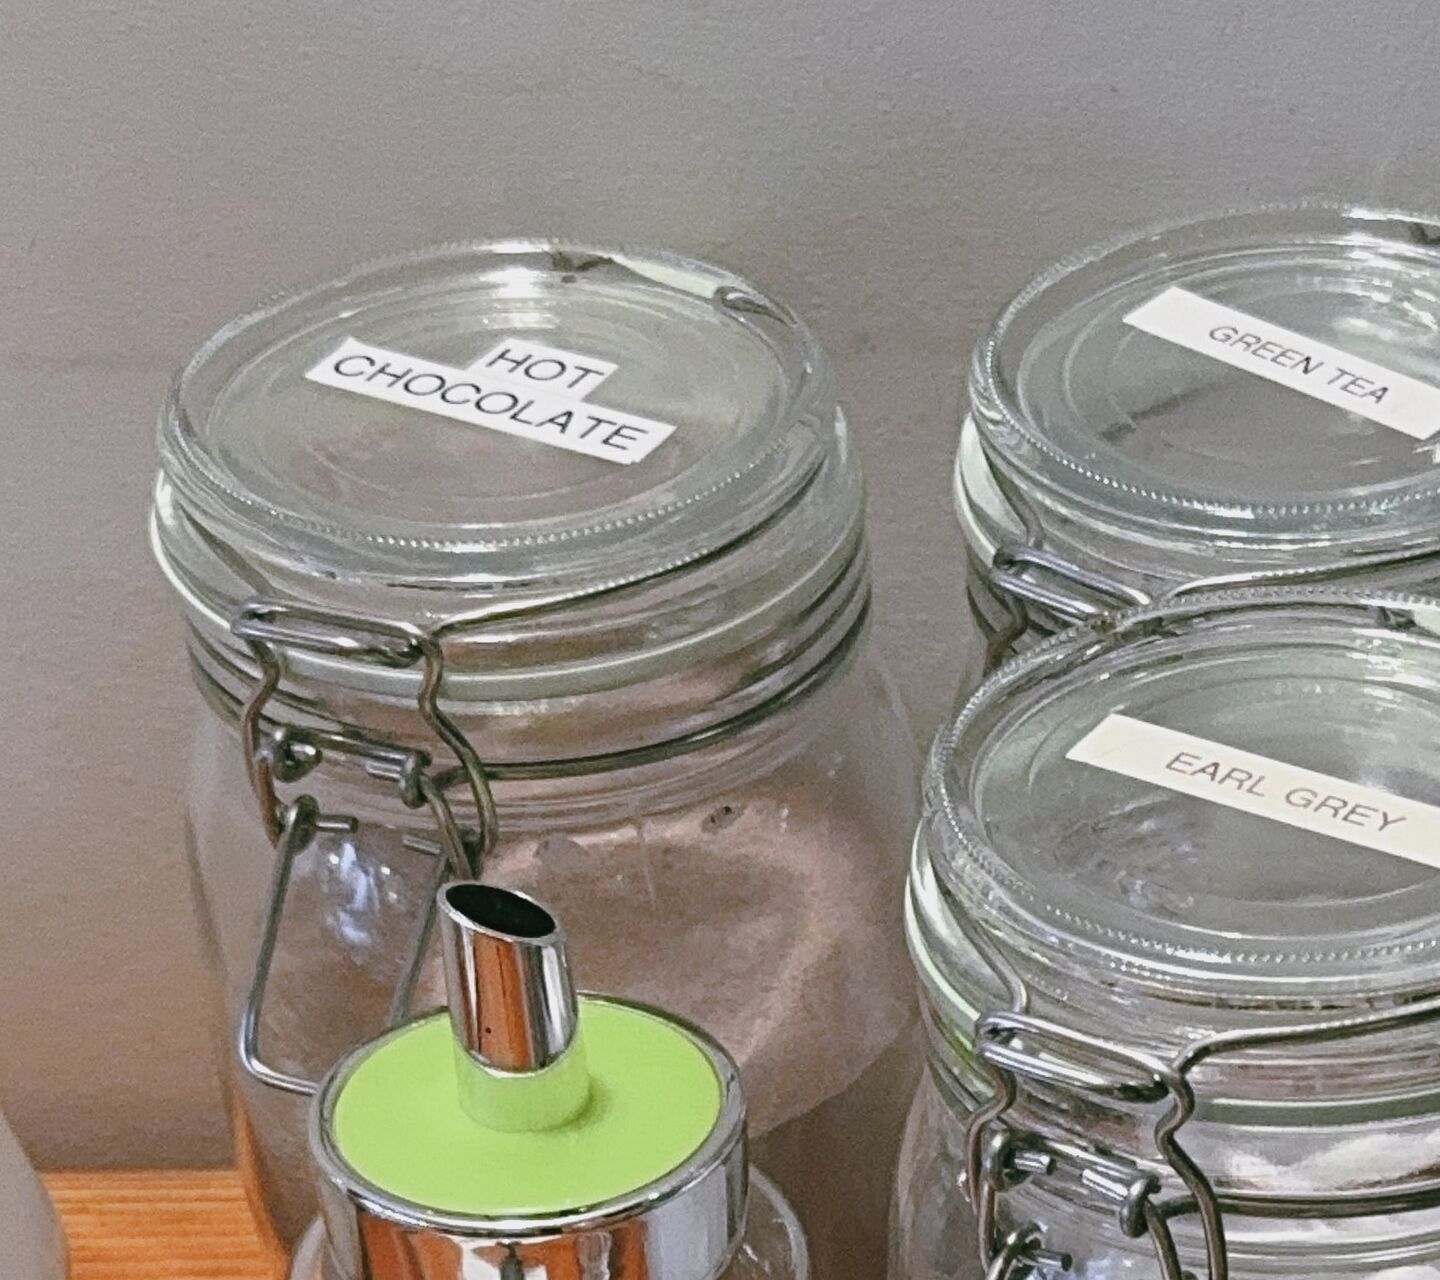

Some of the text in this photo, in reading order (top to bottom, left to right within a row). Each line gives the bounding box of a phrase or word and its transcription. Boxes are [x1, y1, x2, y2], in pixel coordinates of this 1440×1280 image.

[332, 353, 650, 451] CHOCOLATE
[484, 347, 606, 390] HOT
[1207, 324, 1391, 405] GREEN TEA
[1165, 751, 1407, 834] EARL GREY
